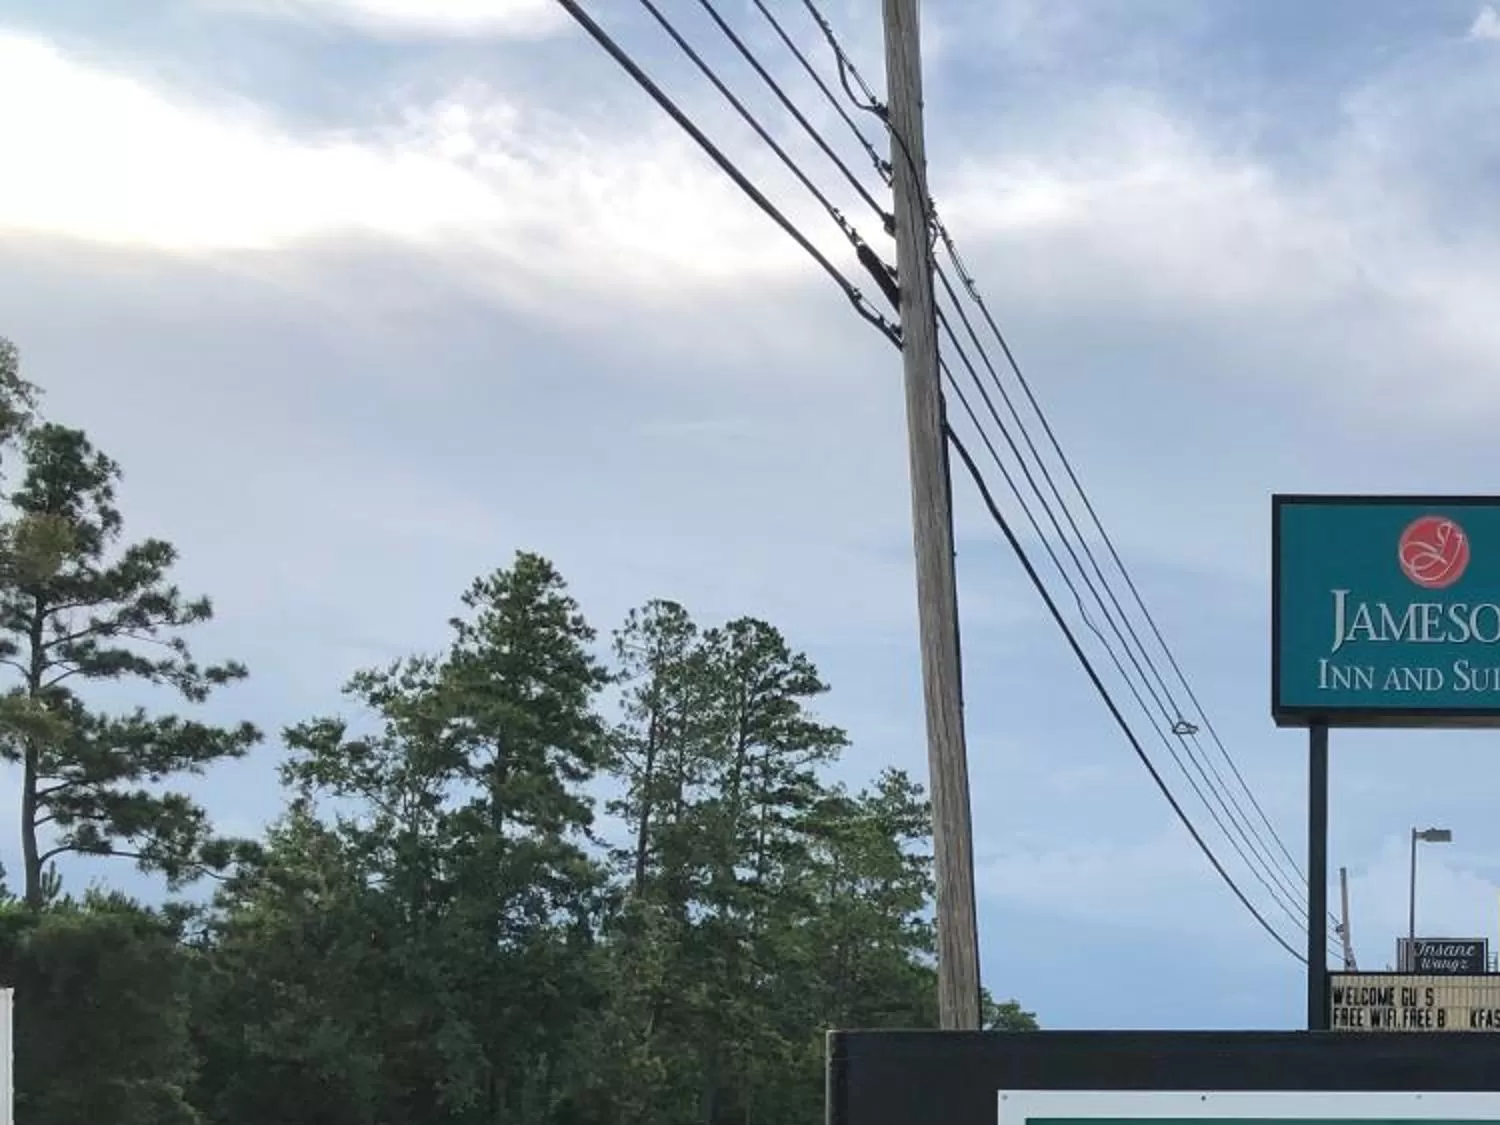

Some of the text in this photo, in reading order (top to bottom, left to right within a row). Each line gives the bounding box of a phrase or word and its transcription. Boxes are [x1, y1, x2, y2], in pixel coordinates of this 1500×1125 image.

[1317, 658, 1375, 690] INN
[1383, 667, 1444, 690] AND
[1416, 943, 1475, 957] Insane
[1333, 986, 1395, 1007] WELCOME
[1333, 1007, 1363, 1028] FREE
[1402, 1007, 1432, 1028] FREE
